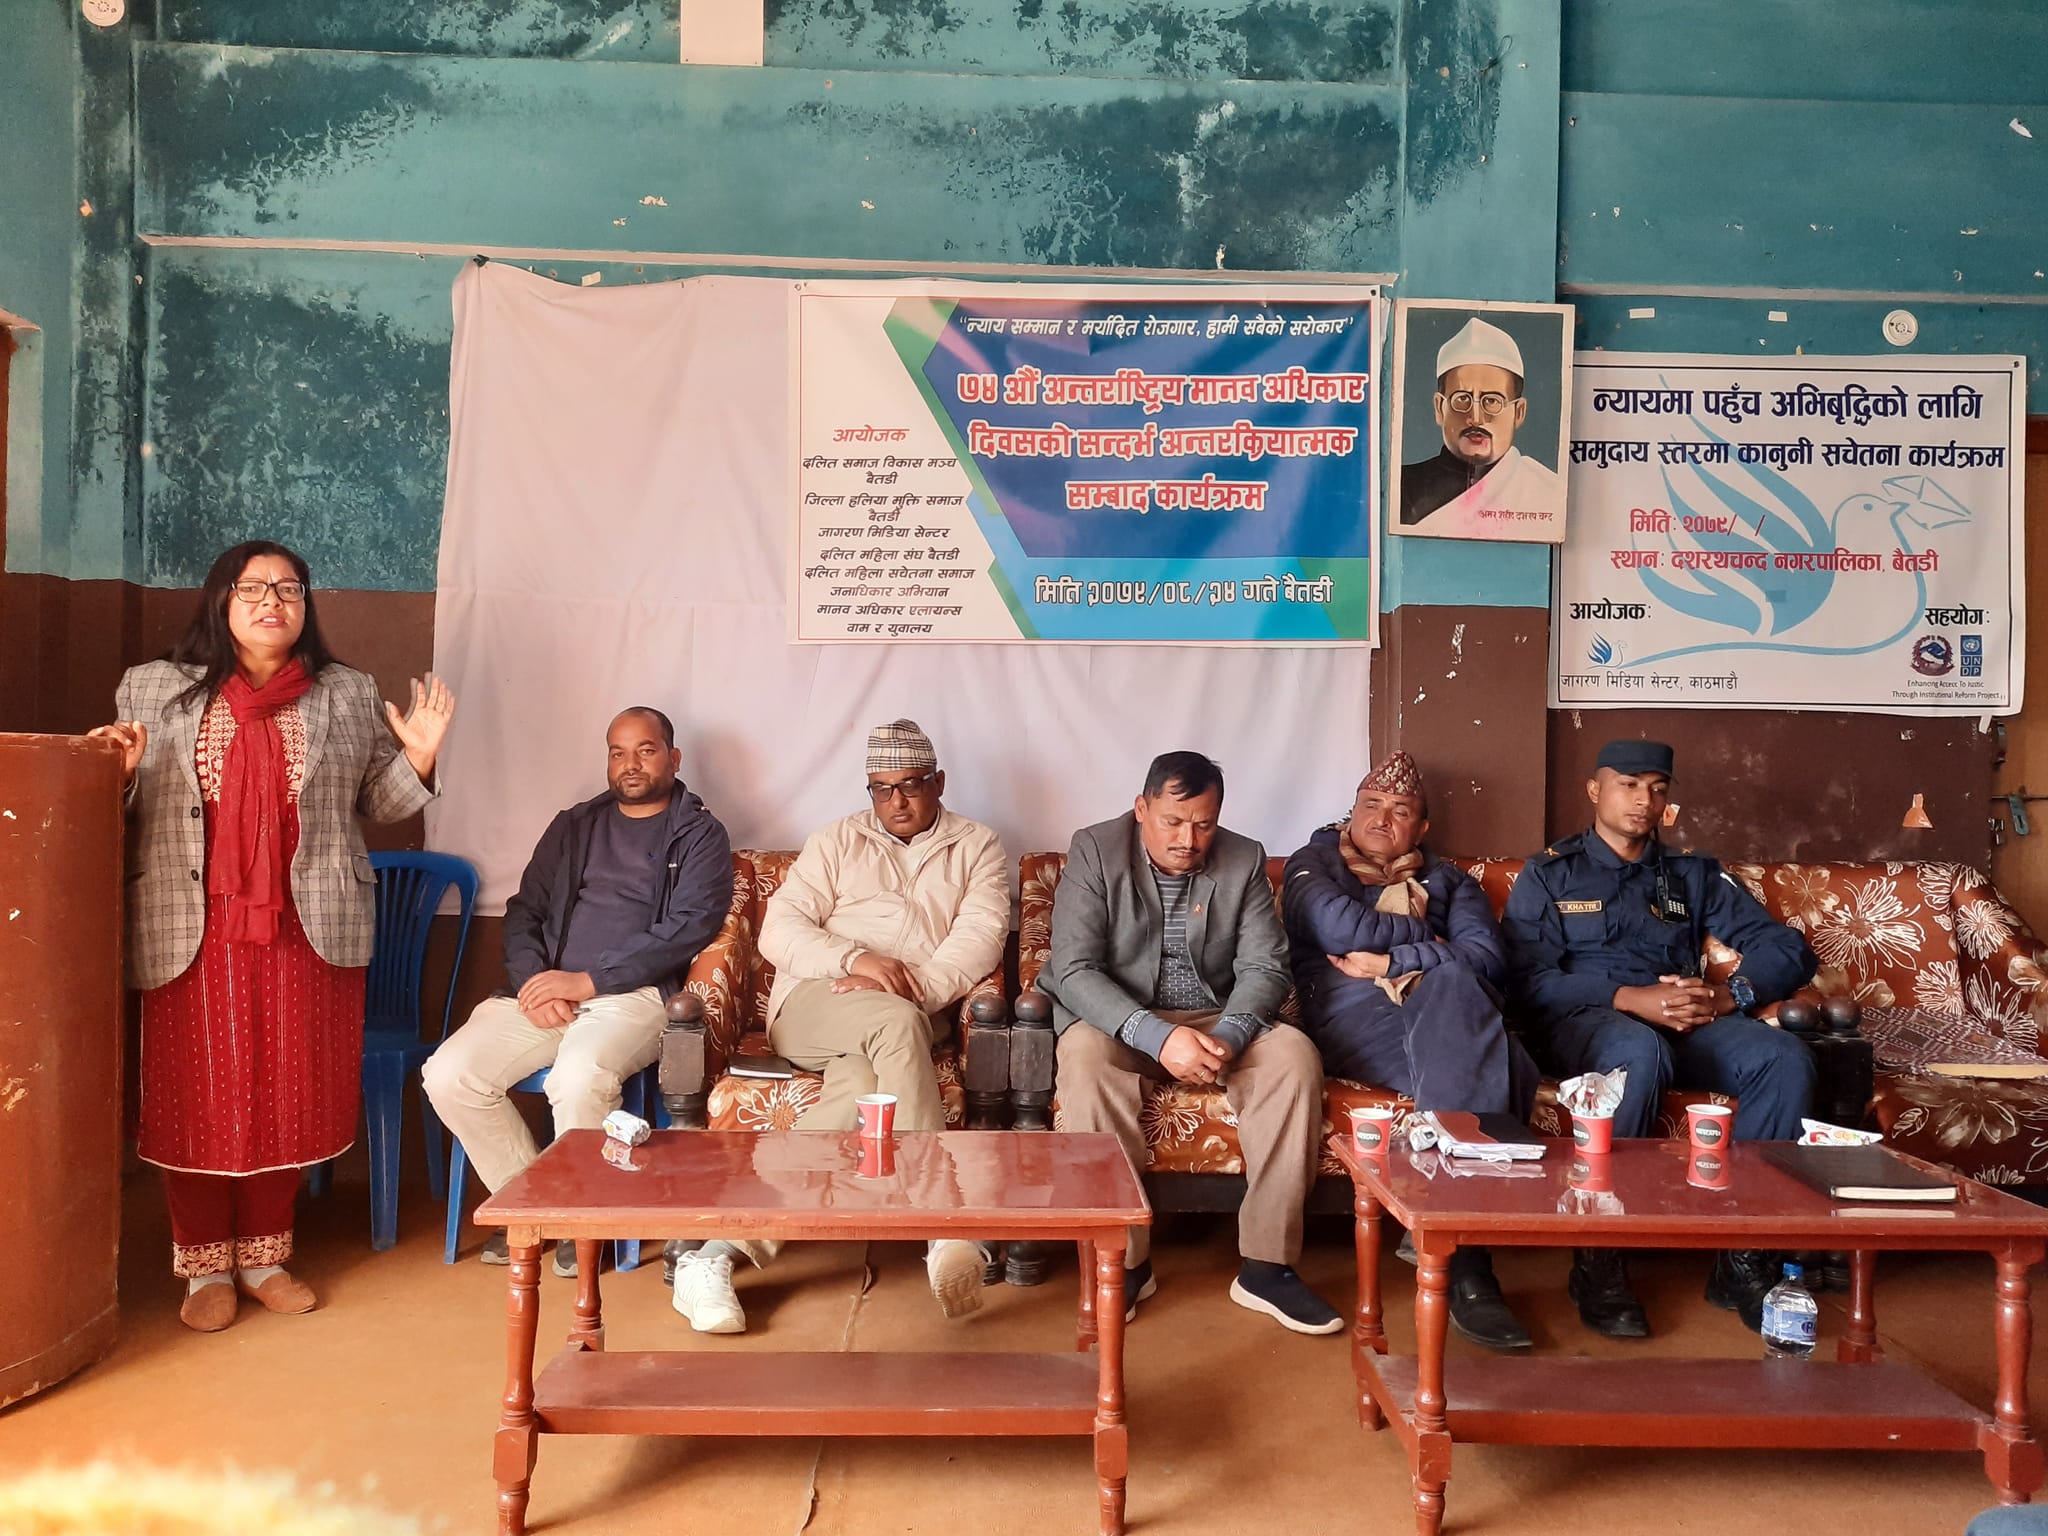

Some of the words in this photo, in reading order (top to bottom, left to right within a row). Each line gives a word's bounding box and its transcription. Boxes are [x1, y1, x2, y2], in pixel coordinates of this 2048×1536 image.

[1011, 318, 1063, 335] सम्मान
[1067, 320, 1078, 335] र
[1082, 315, 1140, 338] मर्यादित
[1143, 315, 1200, 337] रोजगार,
[1206, 314, 1239, 339] हामी
[1243, 314, 1286, 336] सबैको
[957, 373, 998, 404] ७४
[1189, 374, 1261, 404] मानव
[1262, 366, 1369, 404] अधिकार
[1593, 388, 1694, 415] न्यायमा
[1703, 382, 1762, 424] पहुँच
[1917, 384, 1983, 419] लागि
[833, 424, 910, 442] आयोजक
[967, 419, 1075, 459] दिवसको
[1076, 422, 1157, 462] सन्दर्भ
[802, 455, 839, 469] दलित
[842, 458, 881, 469] समाज
[882, 455, 924, 469] विकास
[1570, 440, 1650, 469] समुदाय
[1658, 442, 1730, 465] स्तरमा
[1738, 437, 1814, 471] कानुनी
[1821, 437, 1902, 467] सचेतना
[1909, 440, 2005, 469] कार्यक्रम
[866, 471, 898, 485] बैतडी
[804, 492, 845, 506] जिल्ला
[848, 493, 889, 508] हलिया
[891, 493, 922, 509] मुक्ति
[926, 495, 965, 506] समाज
[1064, 480, 1154, 514] सम्बाद
[1154, 473, 1269, 510] कार्यक्रम
[868, 507, 901, 522] बैतडी
[1538, 512, 1554, 521] चन्द
[818, 527, 865, 538] जागरण
[867, 525, 910, 538] मिडिया
[914, 524, 951, 538] सेन्टर
[820, 547, 856, 561] दलित
[859, 547, 899, 562] महिला
[903, 548, 924, 561] संघ
[927, 547, 960, 561] बैतडी
[1671, 551, 1768, 571] दशरथचन्द
[1892, 547, 1939, 572] बैतडी
[804, 565, 840, 579] दलित
[844, 566, 884, 581] महिला
[888, 566, 933, 579] सचेतना
[937, 568, 976, 579] समाज
[830, 584, 894, 597] जनाधिकार
[897, 584, 950, 597] अभियान
[1034, 575, 1083, 605] मिति
[1242, 574, 1280, 602] गते
[1281, 572, 1335, 603] बैतडी
[816, 604, 852, 615] मानव
[855, 602, 905, 616] अधिकार
[909, 605, 963, 616] एलायन्स
[847, 623, 871, 633] वाम
[875, 623, 884, 633] र
[887, 623, 934, 637] युवालय
[1561, 675, 1600, 689] जागरण
[1606, 671, 1644, 689] मिडिया
[1907, 680, 1939, 689] Enhancing
[1892, 690, 1918, 700] Through
